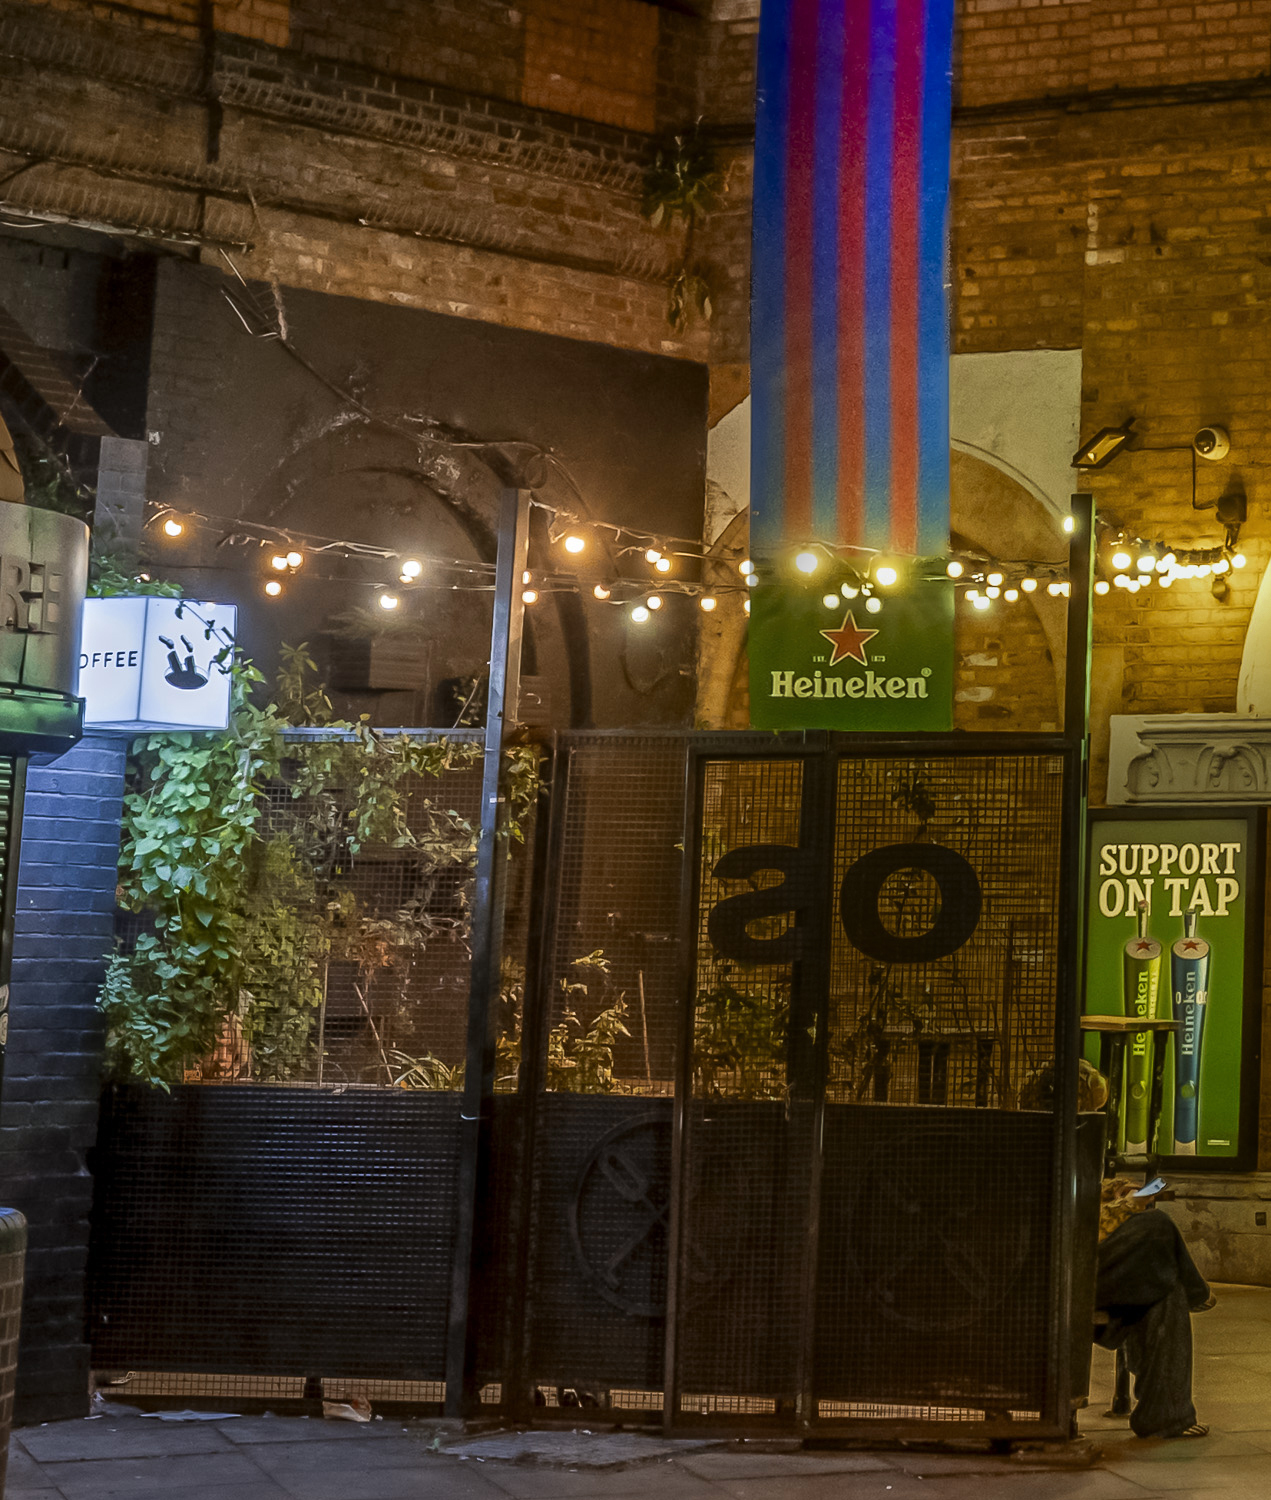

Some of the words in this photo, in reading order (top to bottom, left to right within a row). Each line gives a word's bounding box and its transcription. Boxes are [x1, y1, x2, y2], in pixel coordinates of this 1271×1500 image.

[79, 650, 139, 669] OFFEE
[1100, 843, 1241, 876] SUPPORT
[1099, 878, 1155, 917] ON
[1164, 878, 1240, 917] TAP
[1132, 970, 1149, 1057] Heeken
[1181, 971, 1196, 1056] Heineken
